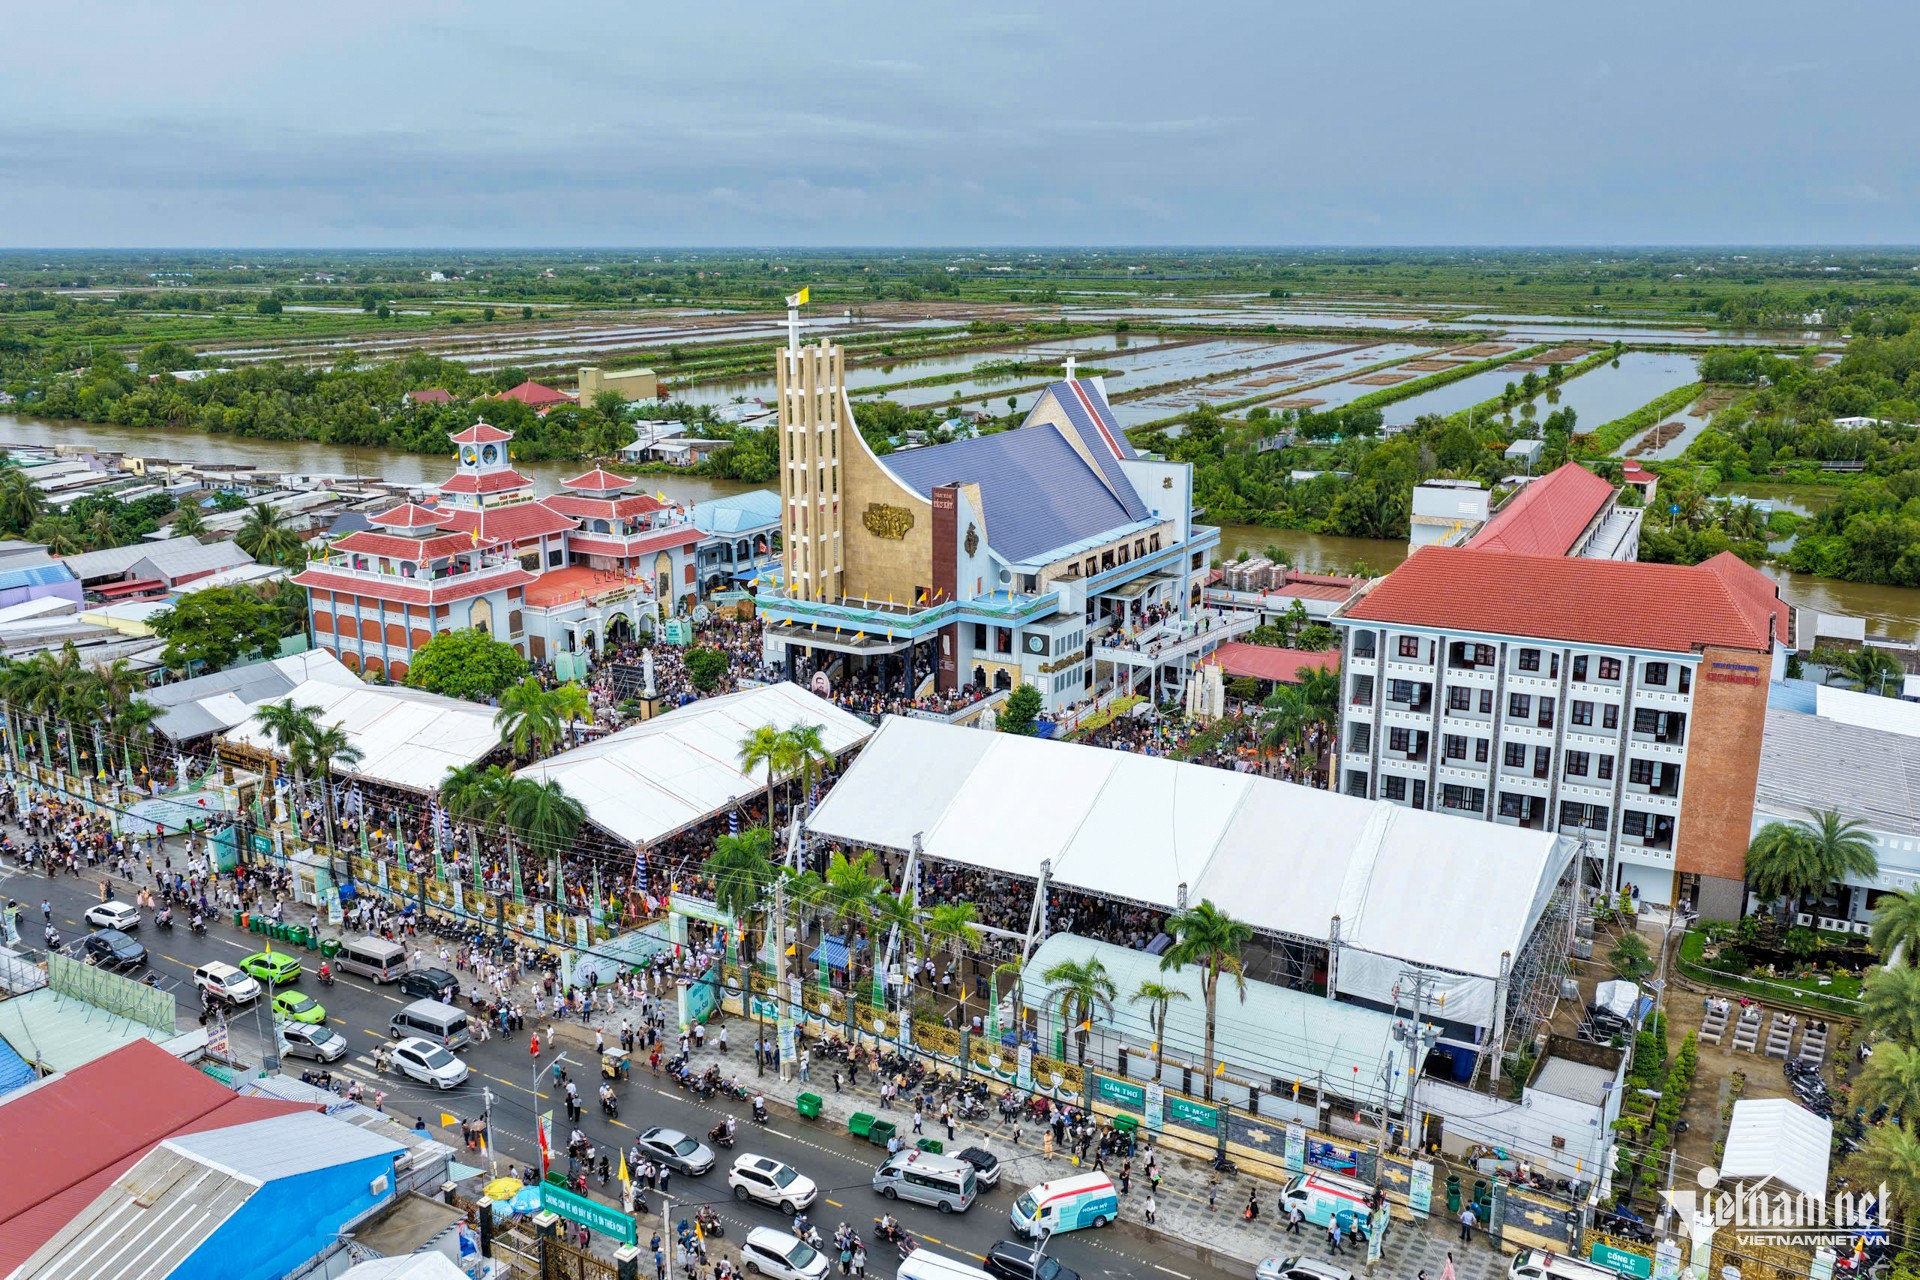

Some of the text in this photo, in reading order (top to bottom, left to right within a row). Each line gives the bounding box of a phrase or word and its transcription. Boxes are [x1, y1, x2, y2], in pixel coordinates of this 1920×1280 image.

[1104, 1082, 1139, 1099] CẦN THƠ
[1178, 1103, 1190, 1113] CÀ
[1630, 1258, 1636, 1266] C
